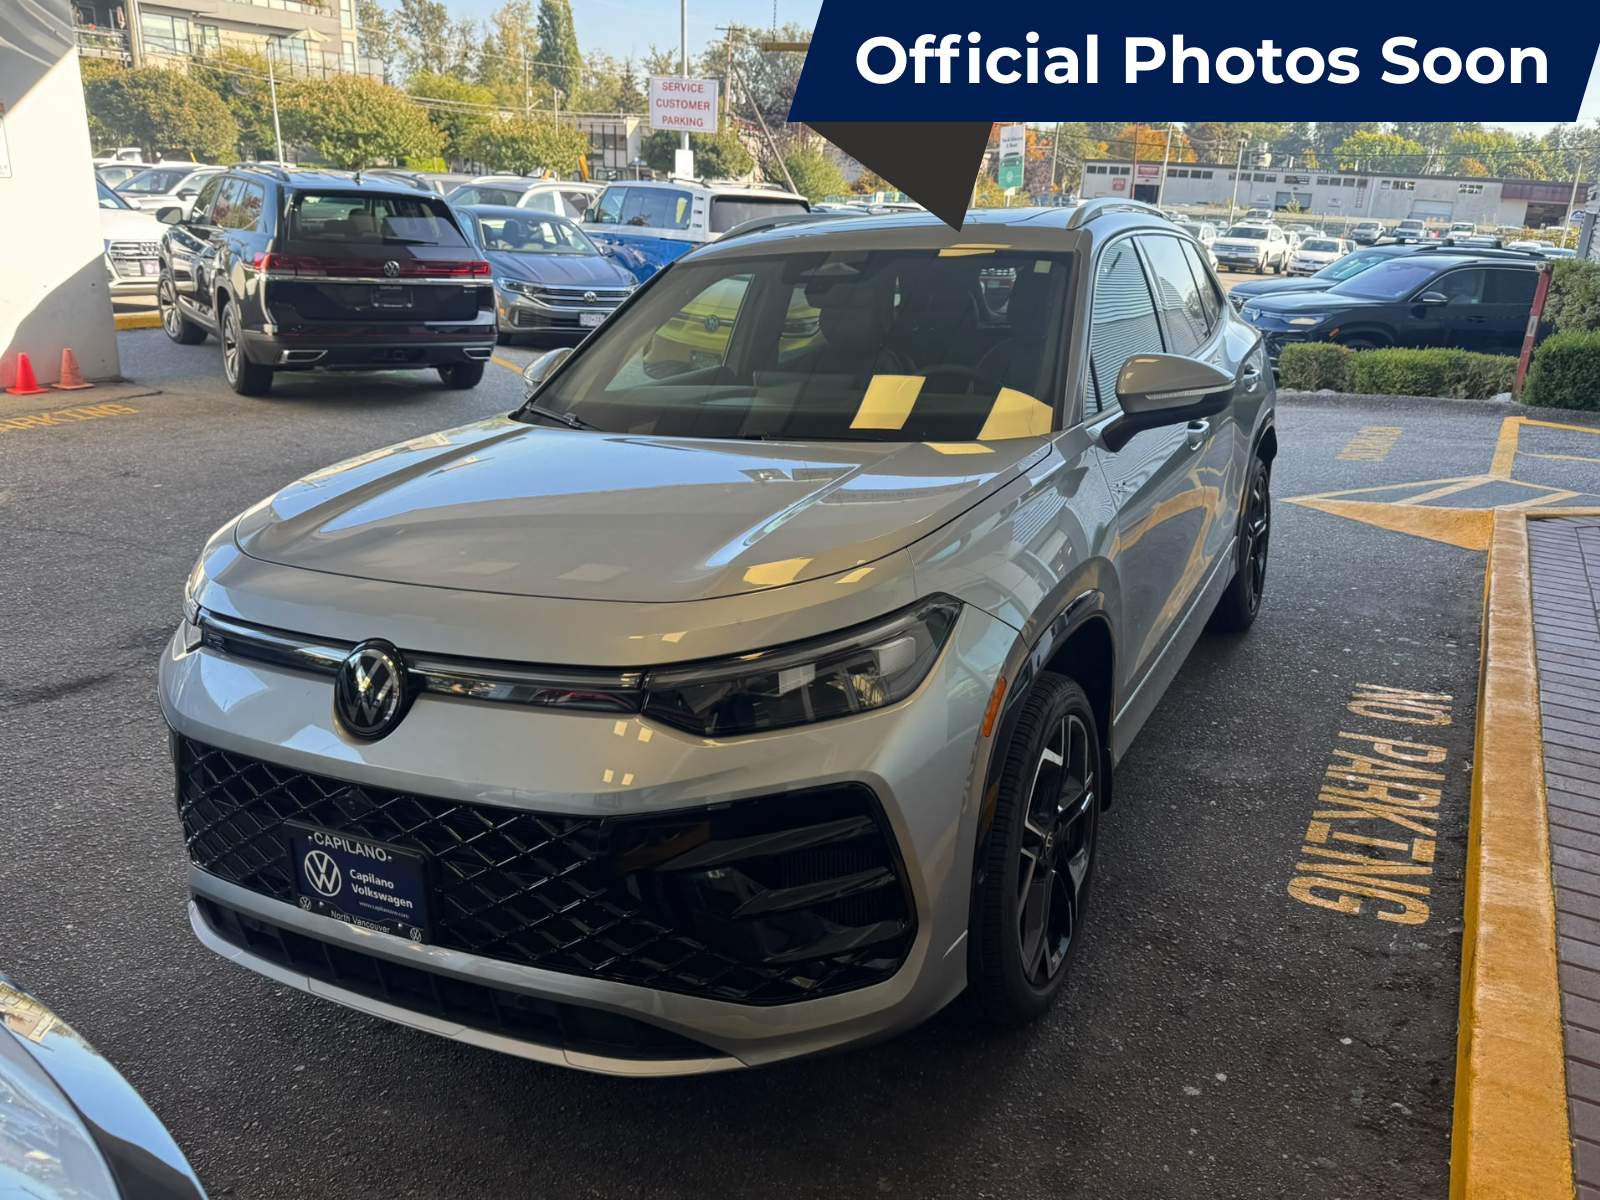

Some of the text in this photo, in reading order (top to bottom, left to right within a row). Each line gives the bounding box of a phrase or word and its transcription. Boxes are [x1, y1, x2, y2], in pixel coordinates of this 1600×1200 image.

[662, 81, 704, 94] SERVICE
[656, 98, 710, 111] CUSTOMER
[662, 115, 704, 127] PARKING
[1346, 683, 1453, 726] NO
[1287, 731, 1447, 925] PARKING
[313, 831, 387, 862] CAPILANO
[349, 868, 395, 890] Capilano
[351, 882, 413, 909] Volkswagen
[331, 910, 390, 934] North Vancouver
